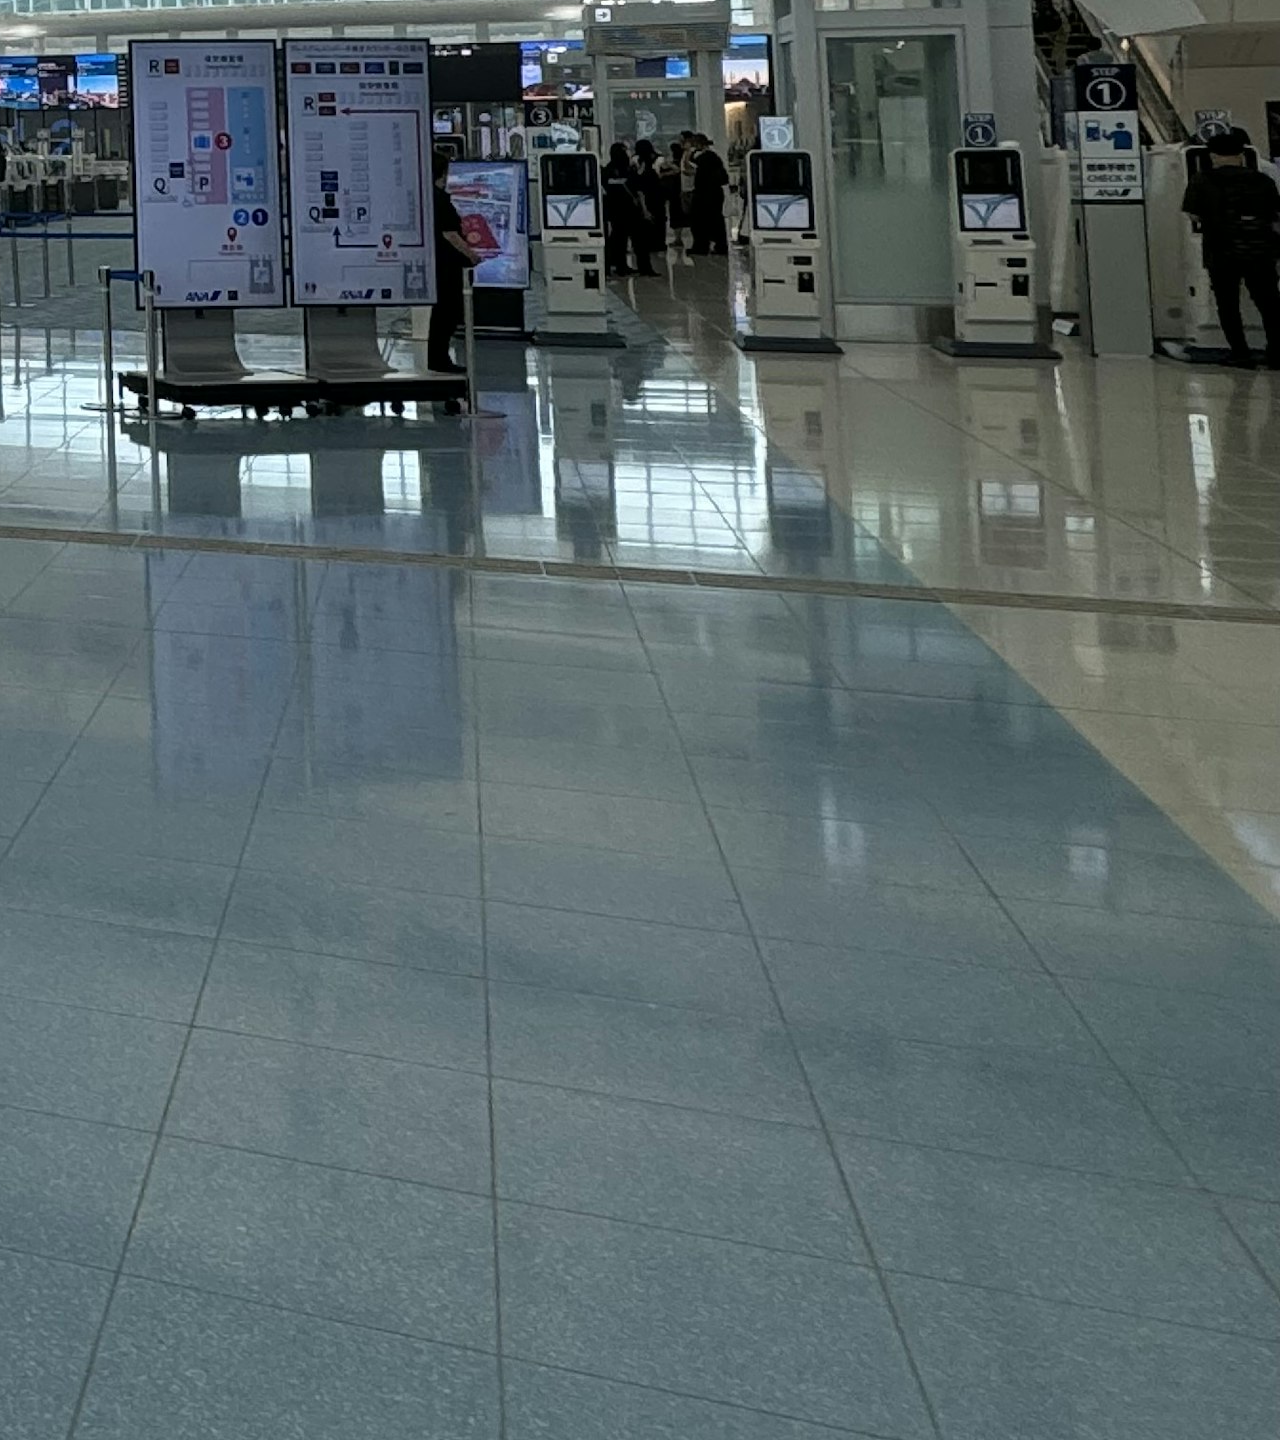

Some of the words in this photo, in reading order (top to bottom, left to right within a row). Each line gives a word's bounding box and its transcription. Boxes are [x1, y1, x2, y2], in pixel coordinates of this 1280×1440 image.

[149, 59, 160, 73] R
[304, 96, 315, 110] R
[153, 177, 167, 194] Q
[199, 177, 209, 191] P
[308, 206, 324, 224] Q
[356, 206, 367, 221] P
